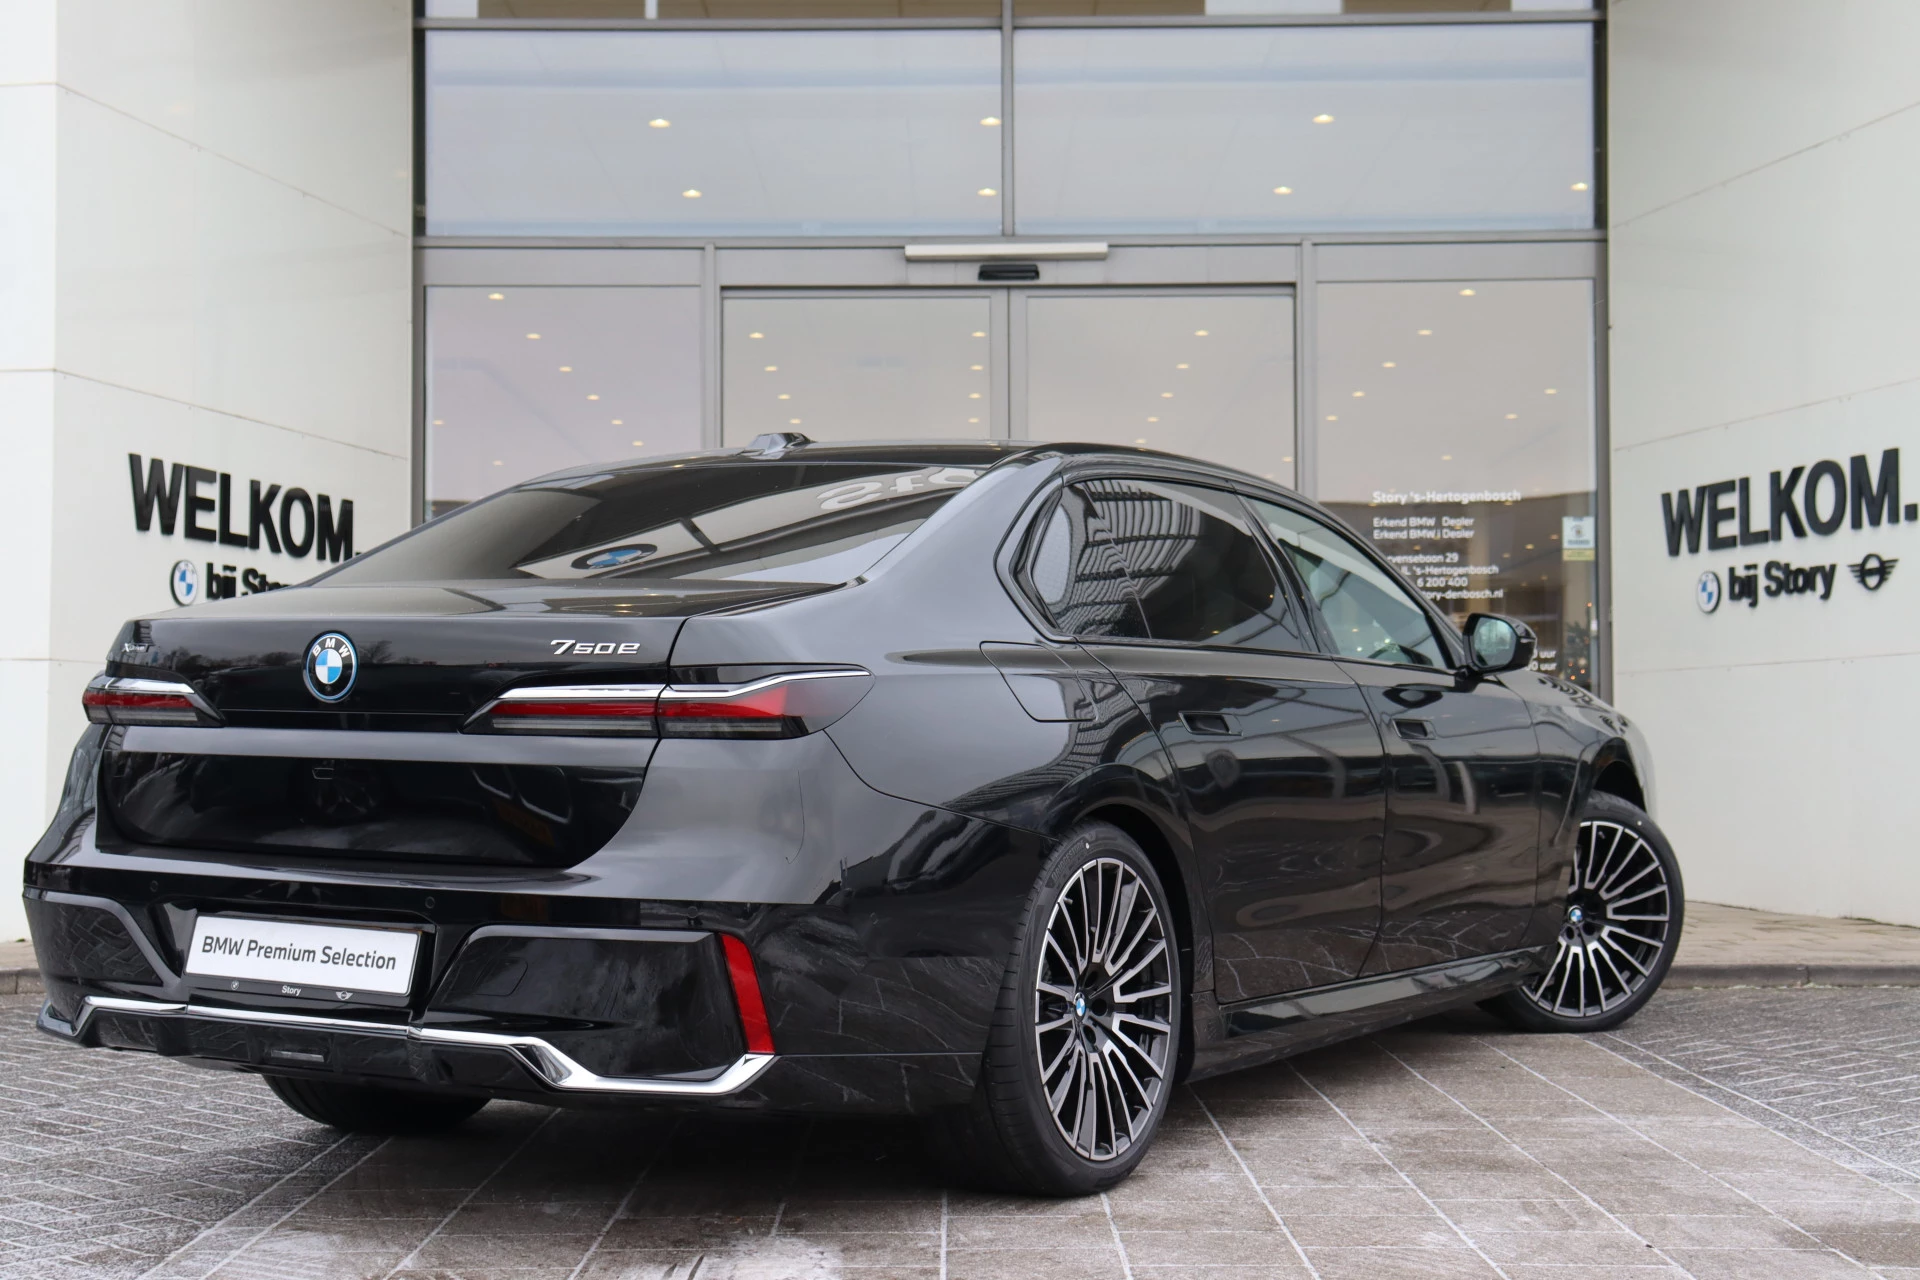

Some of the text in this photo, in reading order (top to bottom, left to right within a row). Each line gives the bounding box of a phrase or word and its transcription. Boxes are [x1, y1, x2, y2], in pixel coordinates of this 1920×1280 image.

[1372, 489, 1522, 505] Story 's-Hertogenbosch
[1661, 447, 1918, 557] WELKOM.
[128, 452, 361, 563] WELKOM
[1372, 516, 1475, 527] Erkend BMW Dealer
[1373, 529, 1407, 539] Erkend
[1442, 529, 1475, 539] Dealer
[1445, 552, 1459, 563] 29
[1413, 565, 1499, 577] 's-Hertogenbosch
[1426, 577, 1446, 587] 200
[1447, 577, 1468, 587] 400
[1763, 560, 1837, 601] Story
[312, 637, 351, 659] BMW
[550, 639, 641, 656] 750e
[1539, 650, 1557, 659] uur
[1540, 662, 1557, 671] uur
[201, 935, 397, 970] BMW Premium Selection
[281, 984, 302, 997] Story
